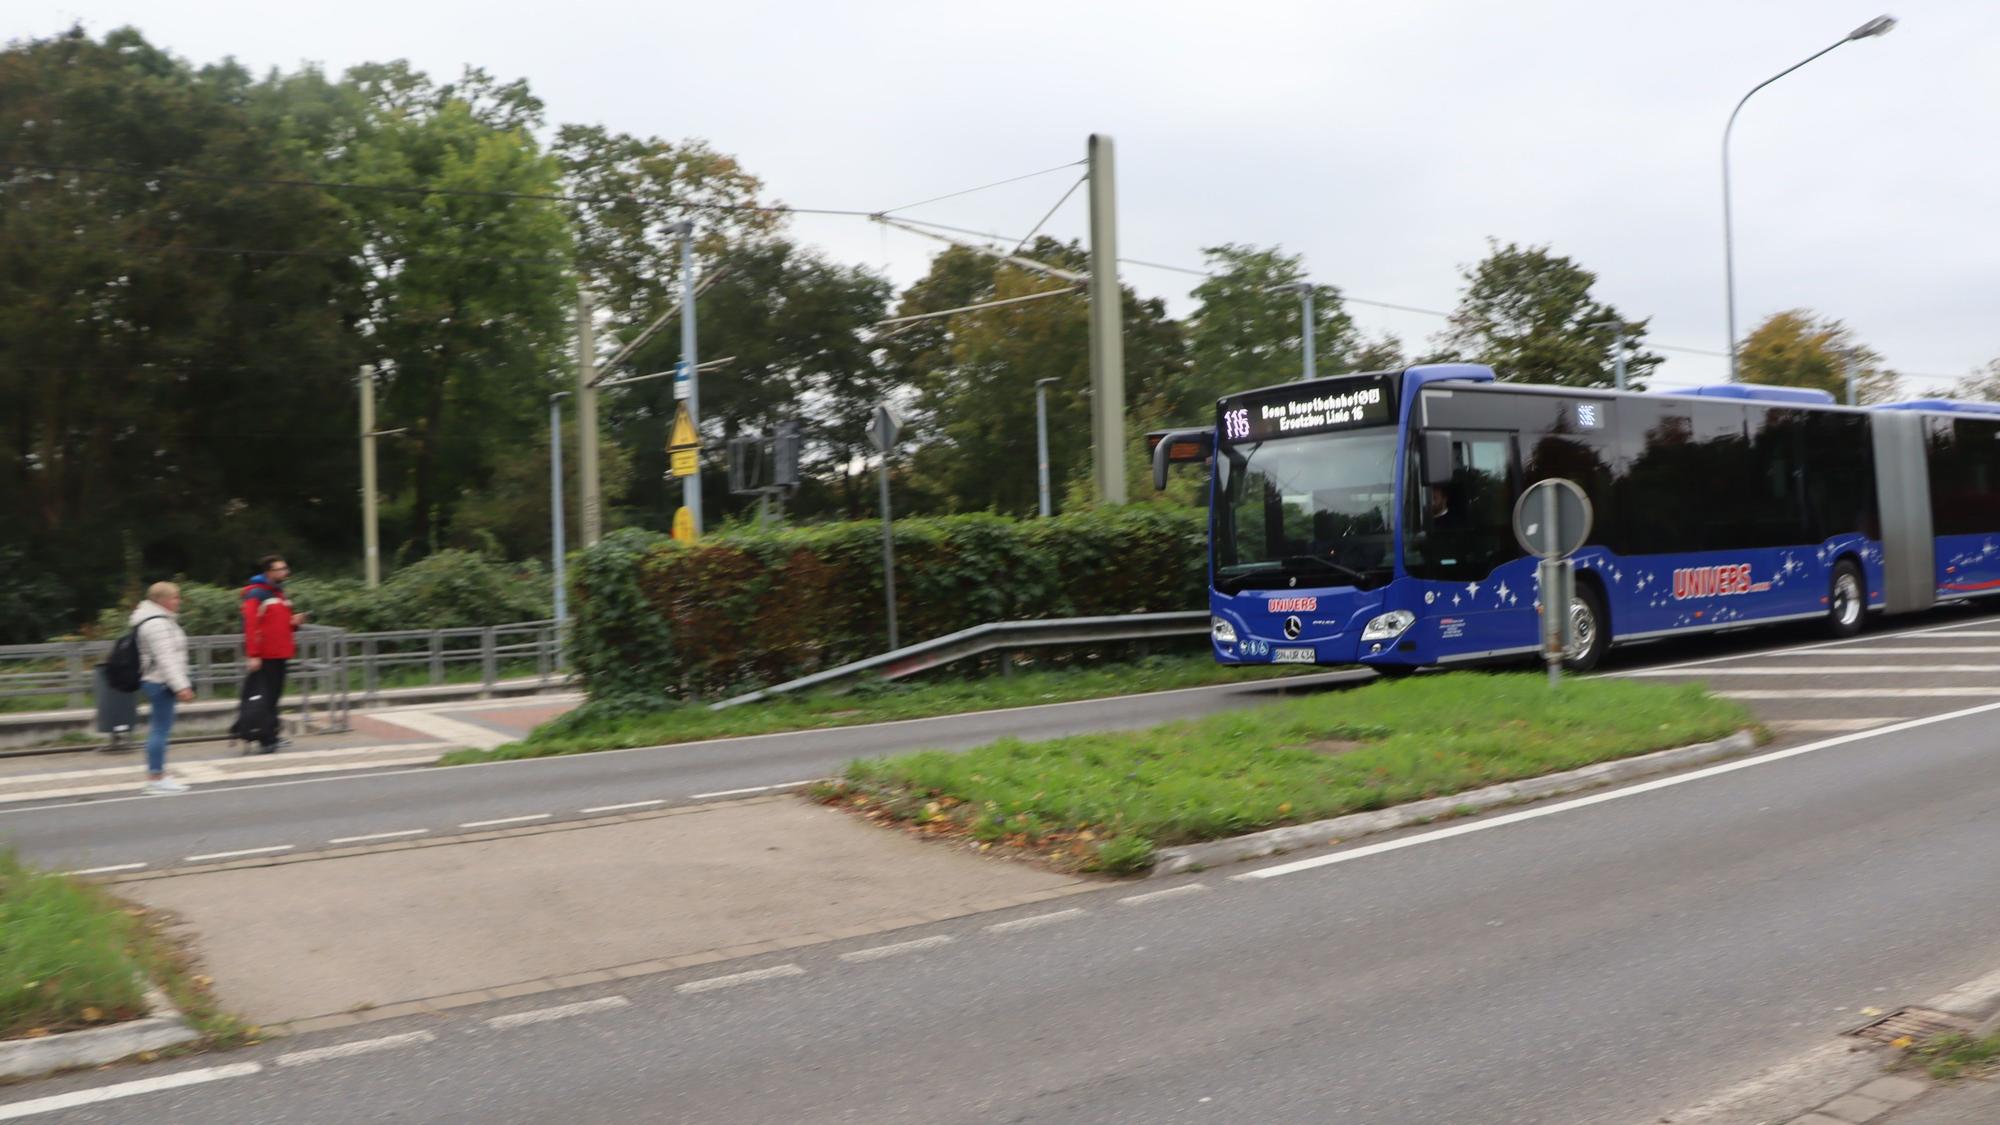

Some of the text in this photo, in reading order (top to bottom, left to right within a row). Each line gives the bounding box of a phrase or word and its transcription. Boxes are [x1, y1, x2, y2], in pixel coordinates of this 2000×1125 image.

[1262, 391, 1359, 419] Bonn Hauptbahnhof
[1279, 405, 1364, 431] Ersatzbus Linie 16
[1224, 409, 1250, 439] 116
[1673, 563, 1751, 600] UNIVERS
[1268, 596, 1317, 613] UNIVERS
